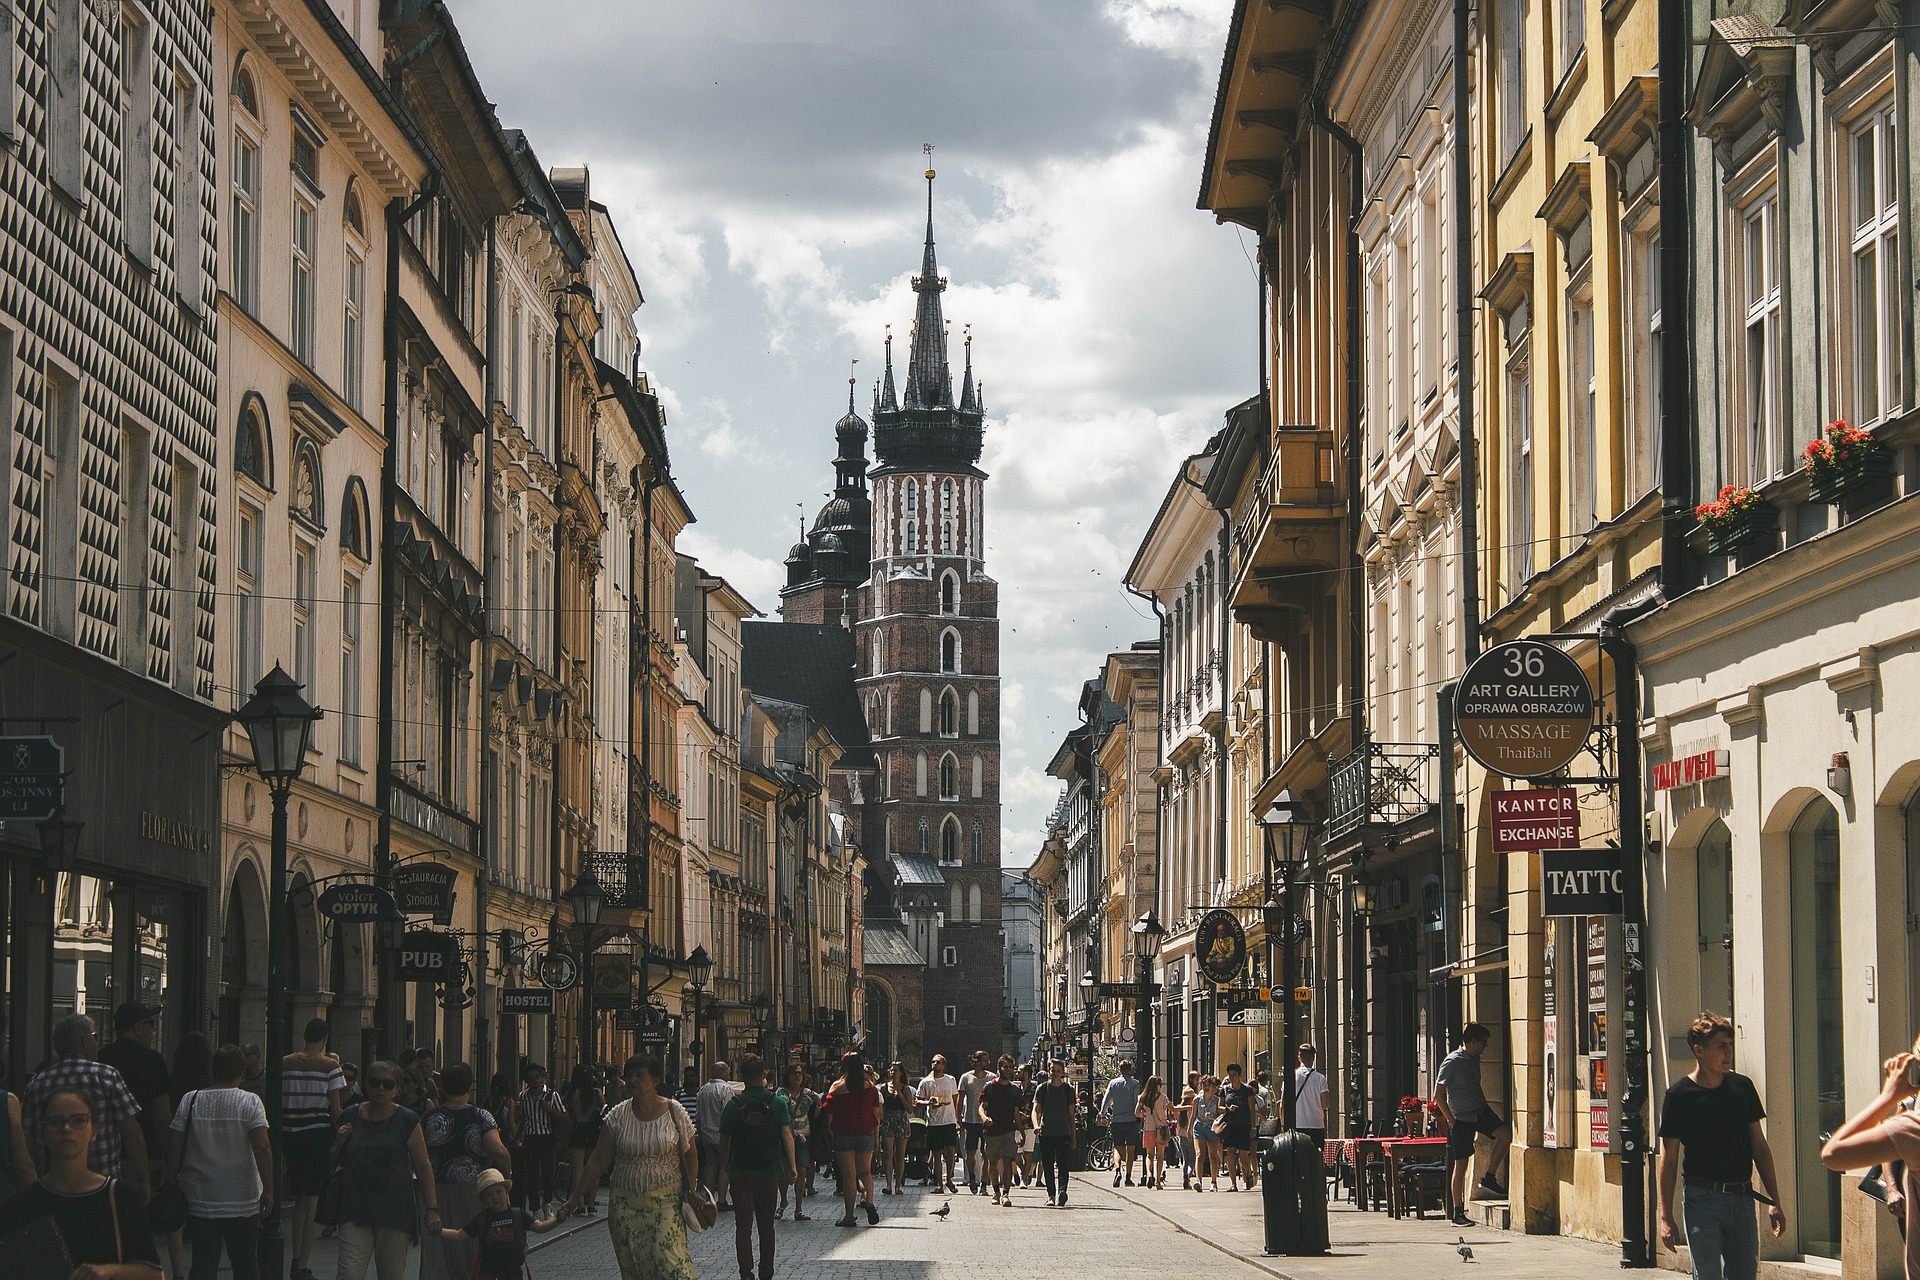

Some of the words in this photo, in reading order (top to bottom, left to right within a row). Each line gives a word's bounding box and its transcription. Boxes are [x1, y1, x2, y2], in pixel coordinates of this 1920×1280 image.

[1503, 647, 1545, 677] 36
[1469, 684, 1501, 698] ART
[1506, 684, 1580, 698] GALLERY
[1464, 703, 1519, 714] OPRAWA
[1521, 700, 1585, 714] OBRAZÓW
[1477, 723, 1571, 740] MASSAGE
[1496, 745, 1552, 760] ThaiBali
[1653, 760, 1682, 791] TALLY
[12, 801, 28, 812] UJ
[1497, 797, 1573, 813] KANTOR
[1499, 826, 1575, 842] EXCHANGE
[398, 872, 447, 885] RESTAURACJA
[1546, 869, 1623, 896] TATTO
[406, 894, 440, 908] STODOŁA
[332, 903, 379, 915] OPTYK
[1199, 930, 1207, 944] PUB
[1206, 913, 1242, 942] RESTAURACJA
[1591, 936, 1605, 950] GALLERY
[401, 951, 443, 969] PUB
[1590, 968, 1605, 983] OPRAWA
[1111, 985, 1143, 995] HOTEL
[1233, 991, 1260, 1003] OPTY
[1590, 983, 1605, 1000] OBRAZÓW
[505, 995, 551, 1007] HOSTEL
[1054, 1045, 1063, 1057] P
[1591, 1110, 1608, 1125] KANTOR
[1592, 1129, 1609, 1144] EXCHANGE
